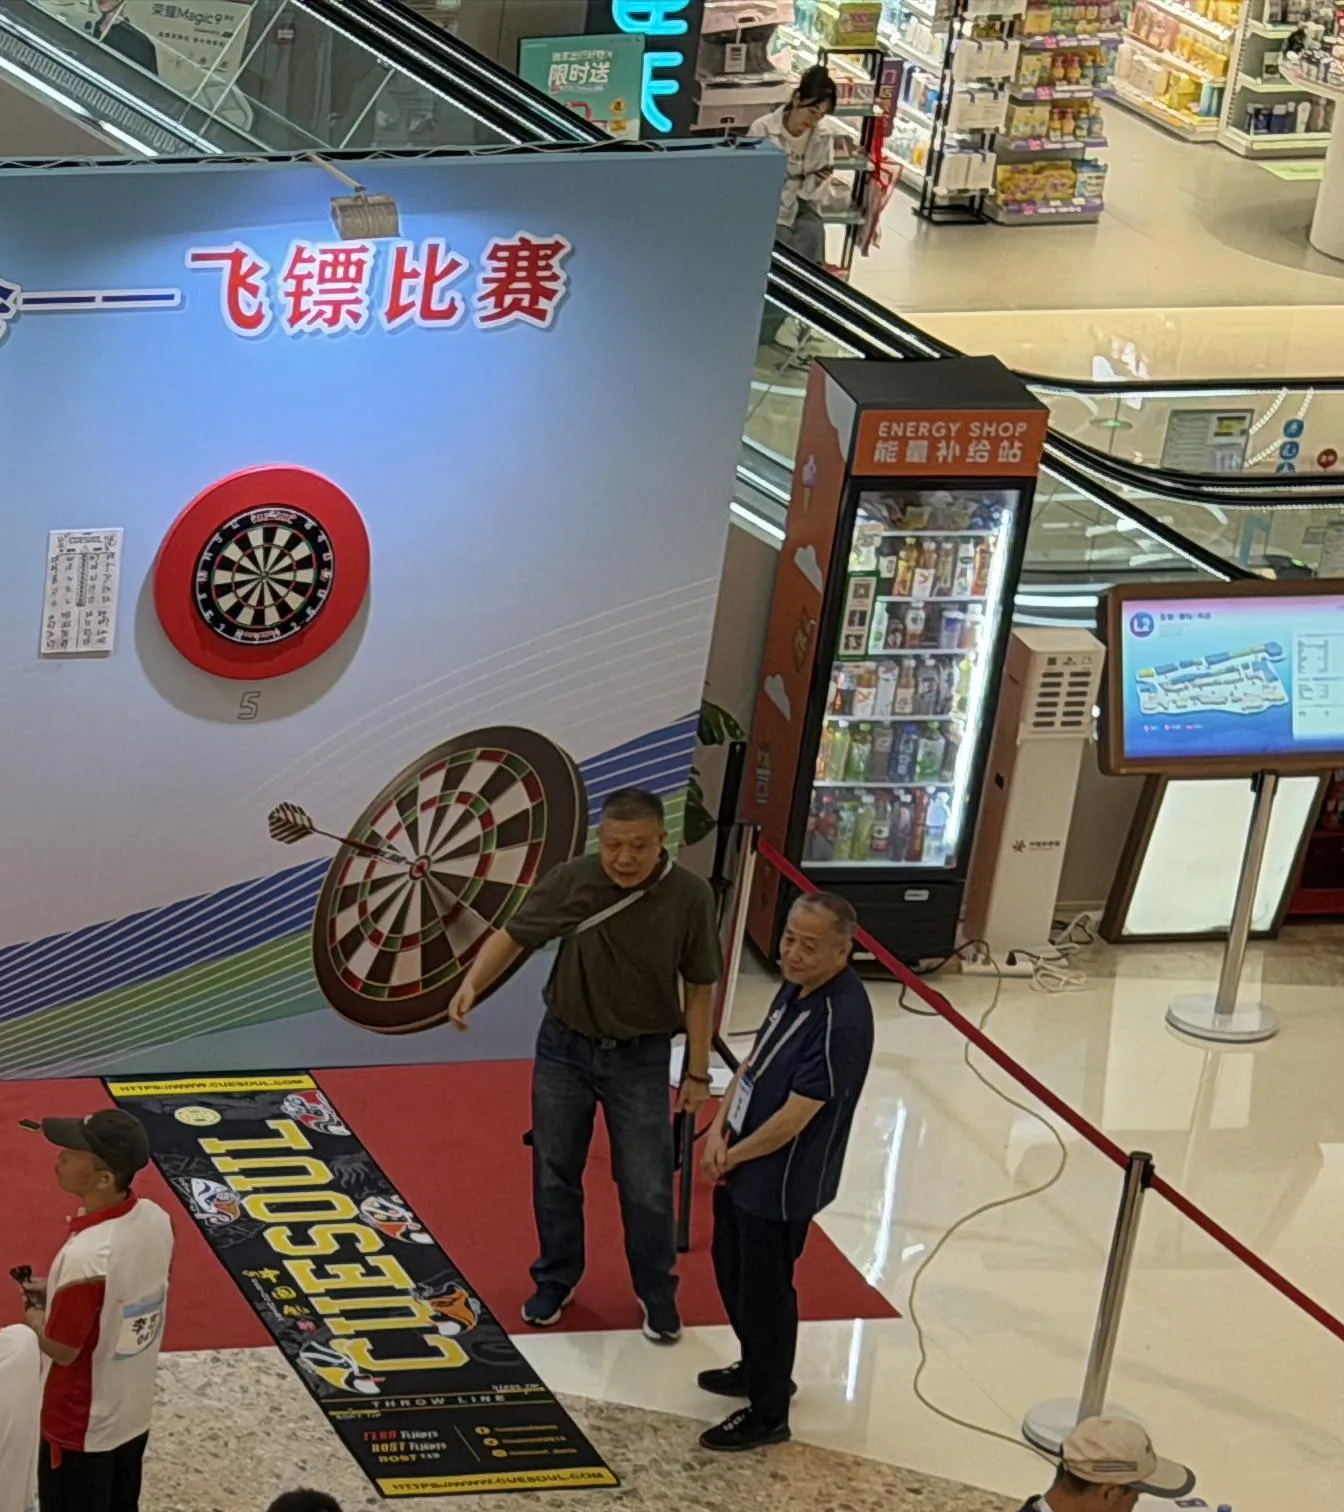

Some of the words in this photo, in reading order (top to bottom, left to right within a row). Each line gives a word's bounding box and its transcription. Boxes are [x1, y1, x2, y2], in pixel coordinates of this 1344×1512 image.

[878, 421, 961, 437] ENERGY
[969, 421, 1028, 437] SHOP
[874, 439, 1025, 463] 能量补给站
[236, 690, 262, 721] 5
[199, 1118, 472, 1372] CUESOUL
[372, 1397, 445, 1408] THROW
[458, 1394, 506, 1404] LINE
